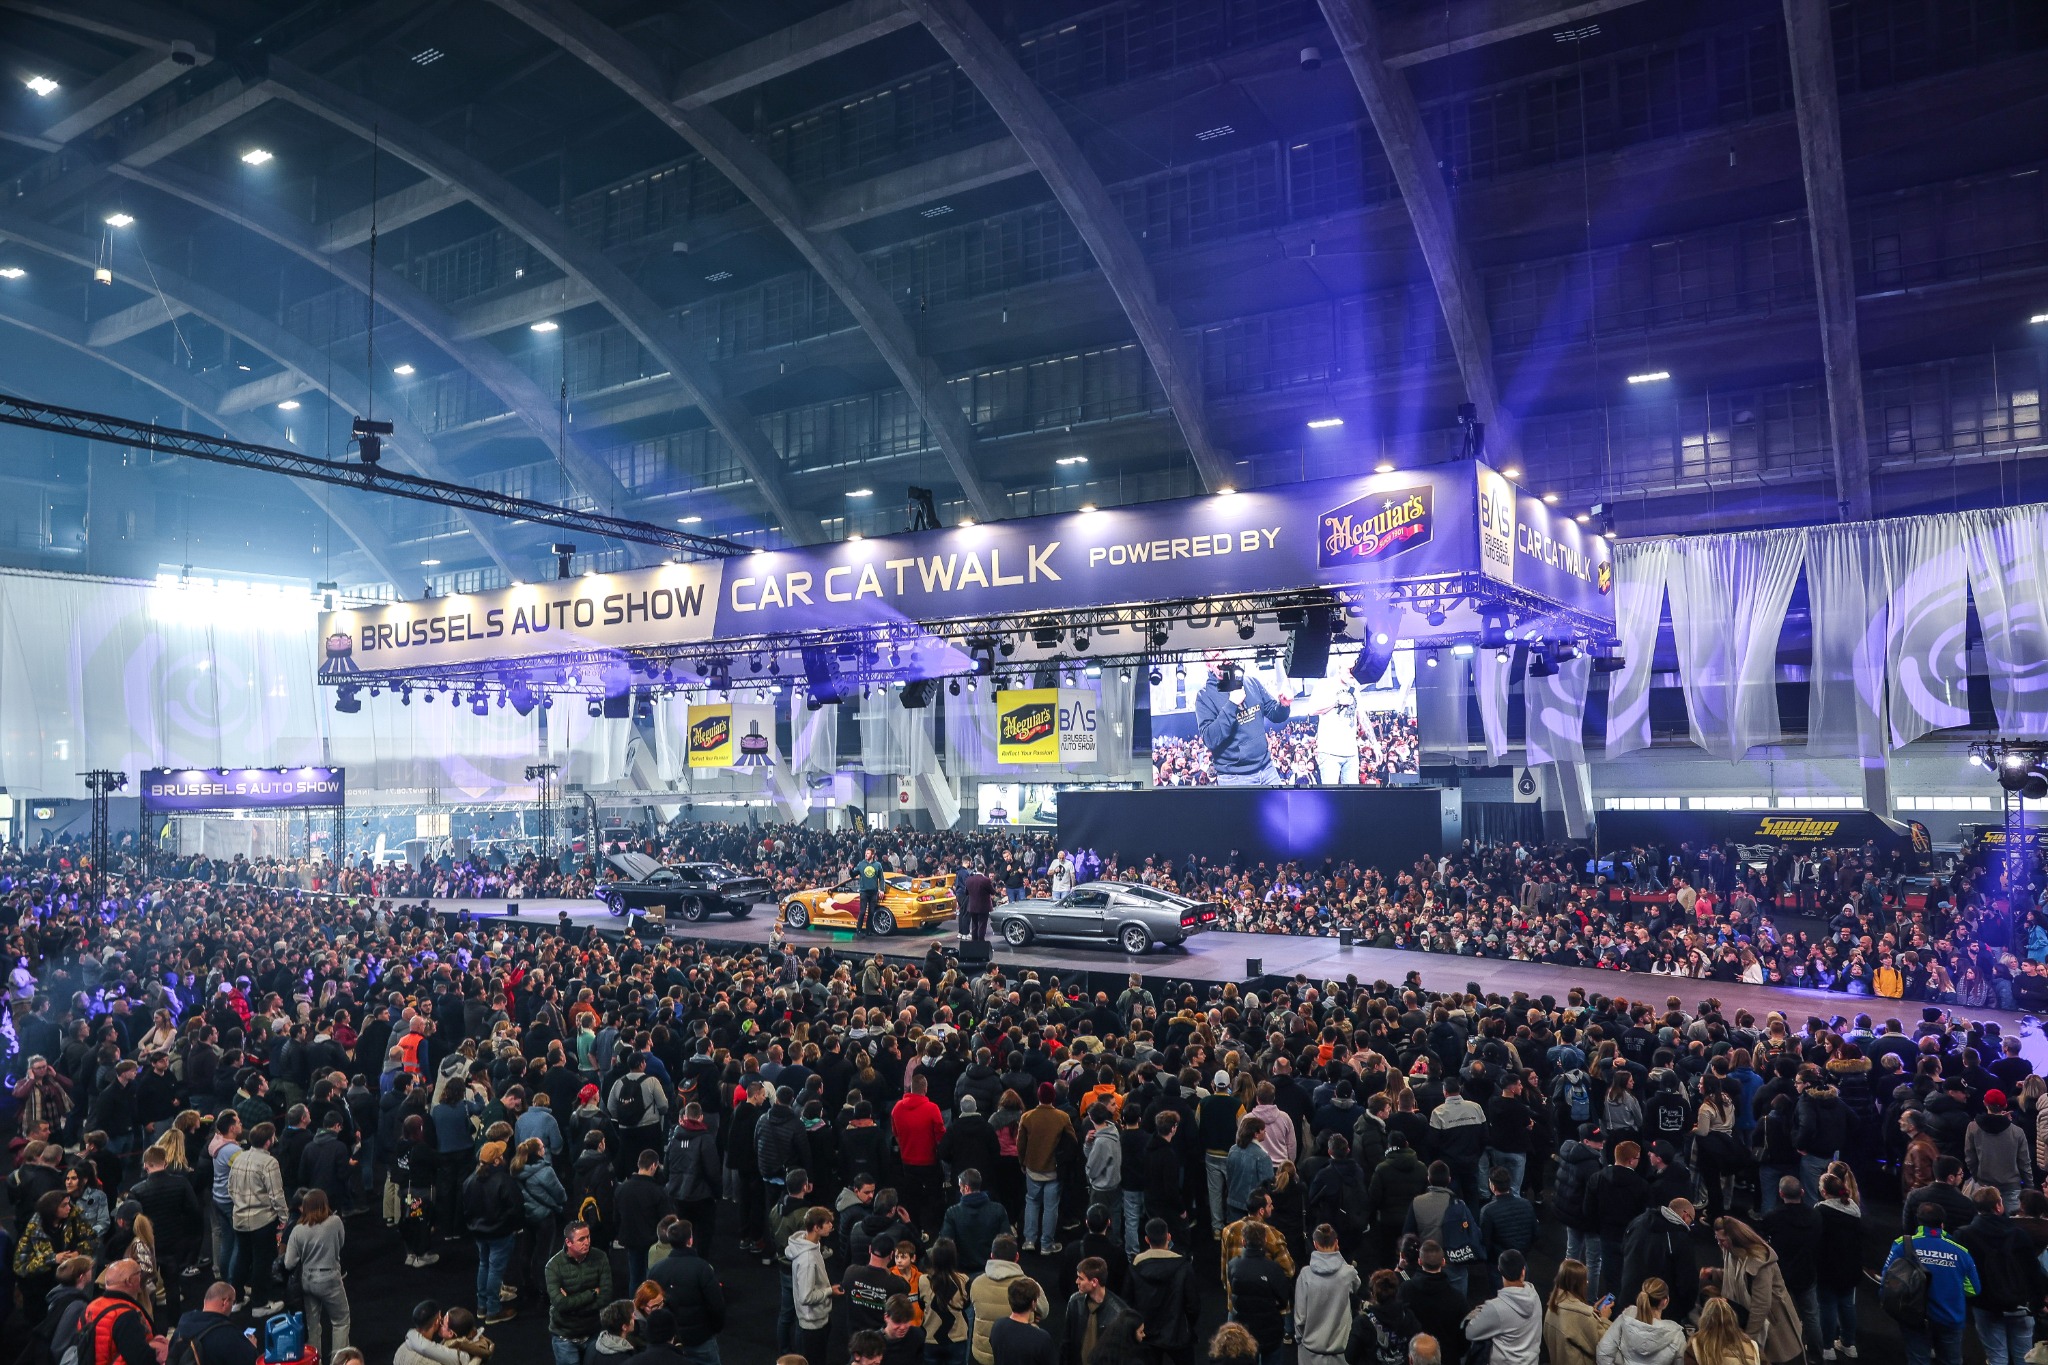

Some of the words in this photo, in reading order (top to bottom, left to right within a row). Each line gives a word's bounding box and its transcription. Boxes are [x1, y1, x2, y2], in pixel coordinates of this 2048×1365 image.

[1324, 494, 1426, 557] Meguiar's
[1089, 533, 1233, 567] POWERED
[1240, 527, 1282, 553] BY
[1483, 544, 1497, 561] AUTO
[1495, 550, 1511, 567] SHOW
[1484, 532, 1509, 555] BRUSSELS
[1517, 522, 1543, 561] CAR
[1543, 536, 1592, 583] CATWALK
[731, 571, 814, 613] CAR
[824, 541, 1063, 604] CATWALK
[361, 608, 504, 651] BRUSSELS
[511, 598, 595, 635] AUTO
[603, 584, 705, 625] SHOW
[1003, 707, 1051, 740] Meguiar's
[1059, 700, 1097, 732] BAS
[693, 719, 727, 747] Meguiar's
[1060, 743, 1077, 751] AUTO
[1077, 743, 1096, 751] SHOW
[1063, 734, 1094, 743] BRUSSELS
[151, 783, 247, 797] BRUSSELS
[250, 782, 293, 795] AUTO
[296, 781, 340, 793] SHOW
[1524, 782, 1530, 790] 4
[1915, 1249, 1958, 1261] SUZUKI
